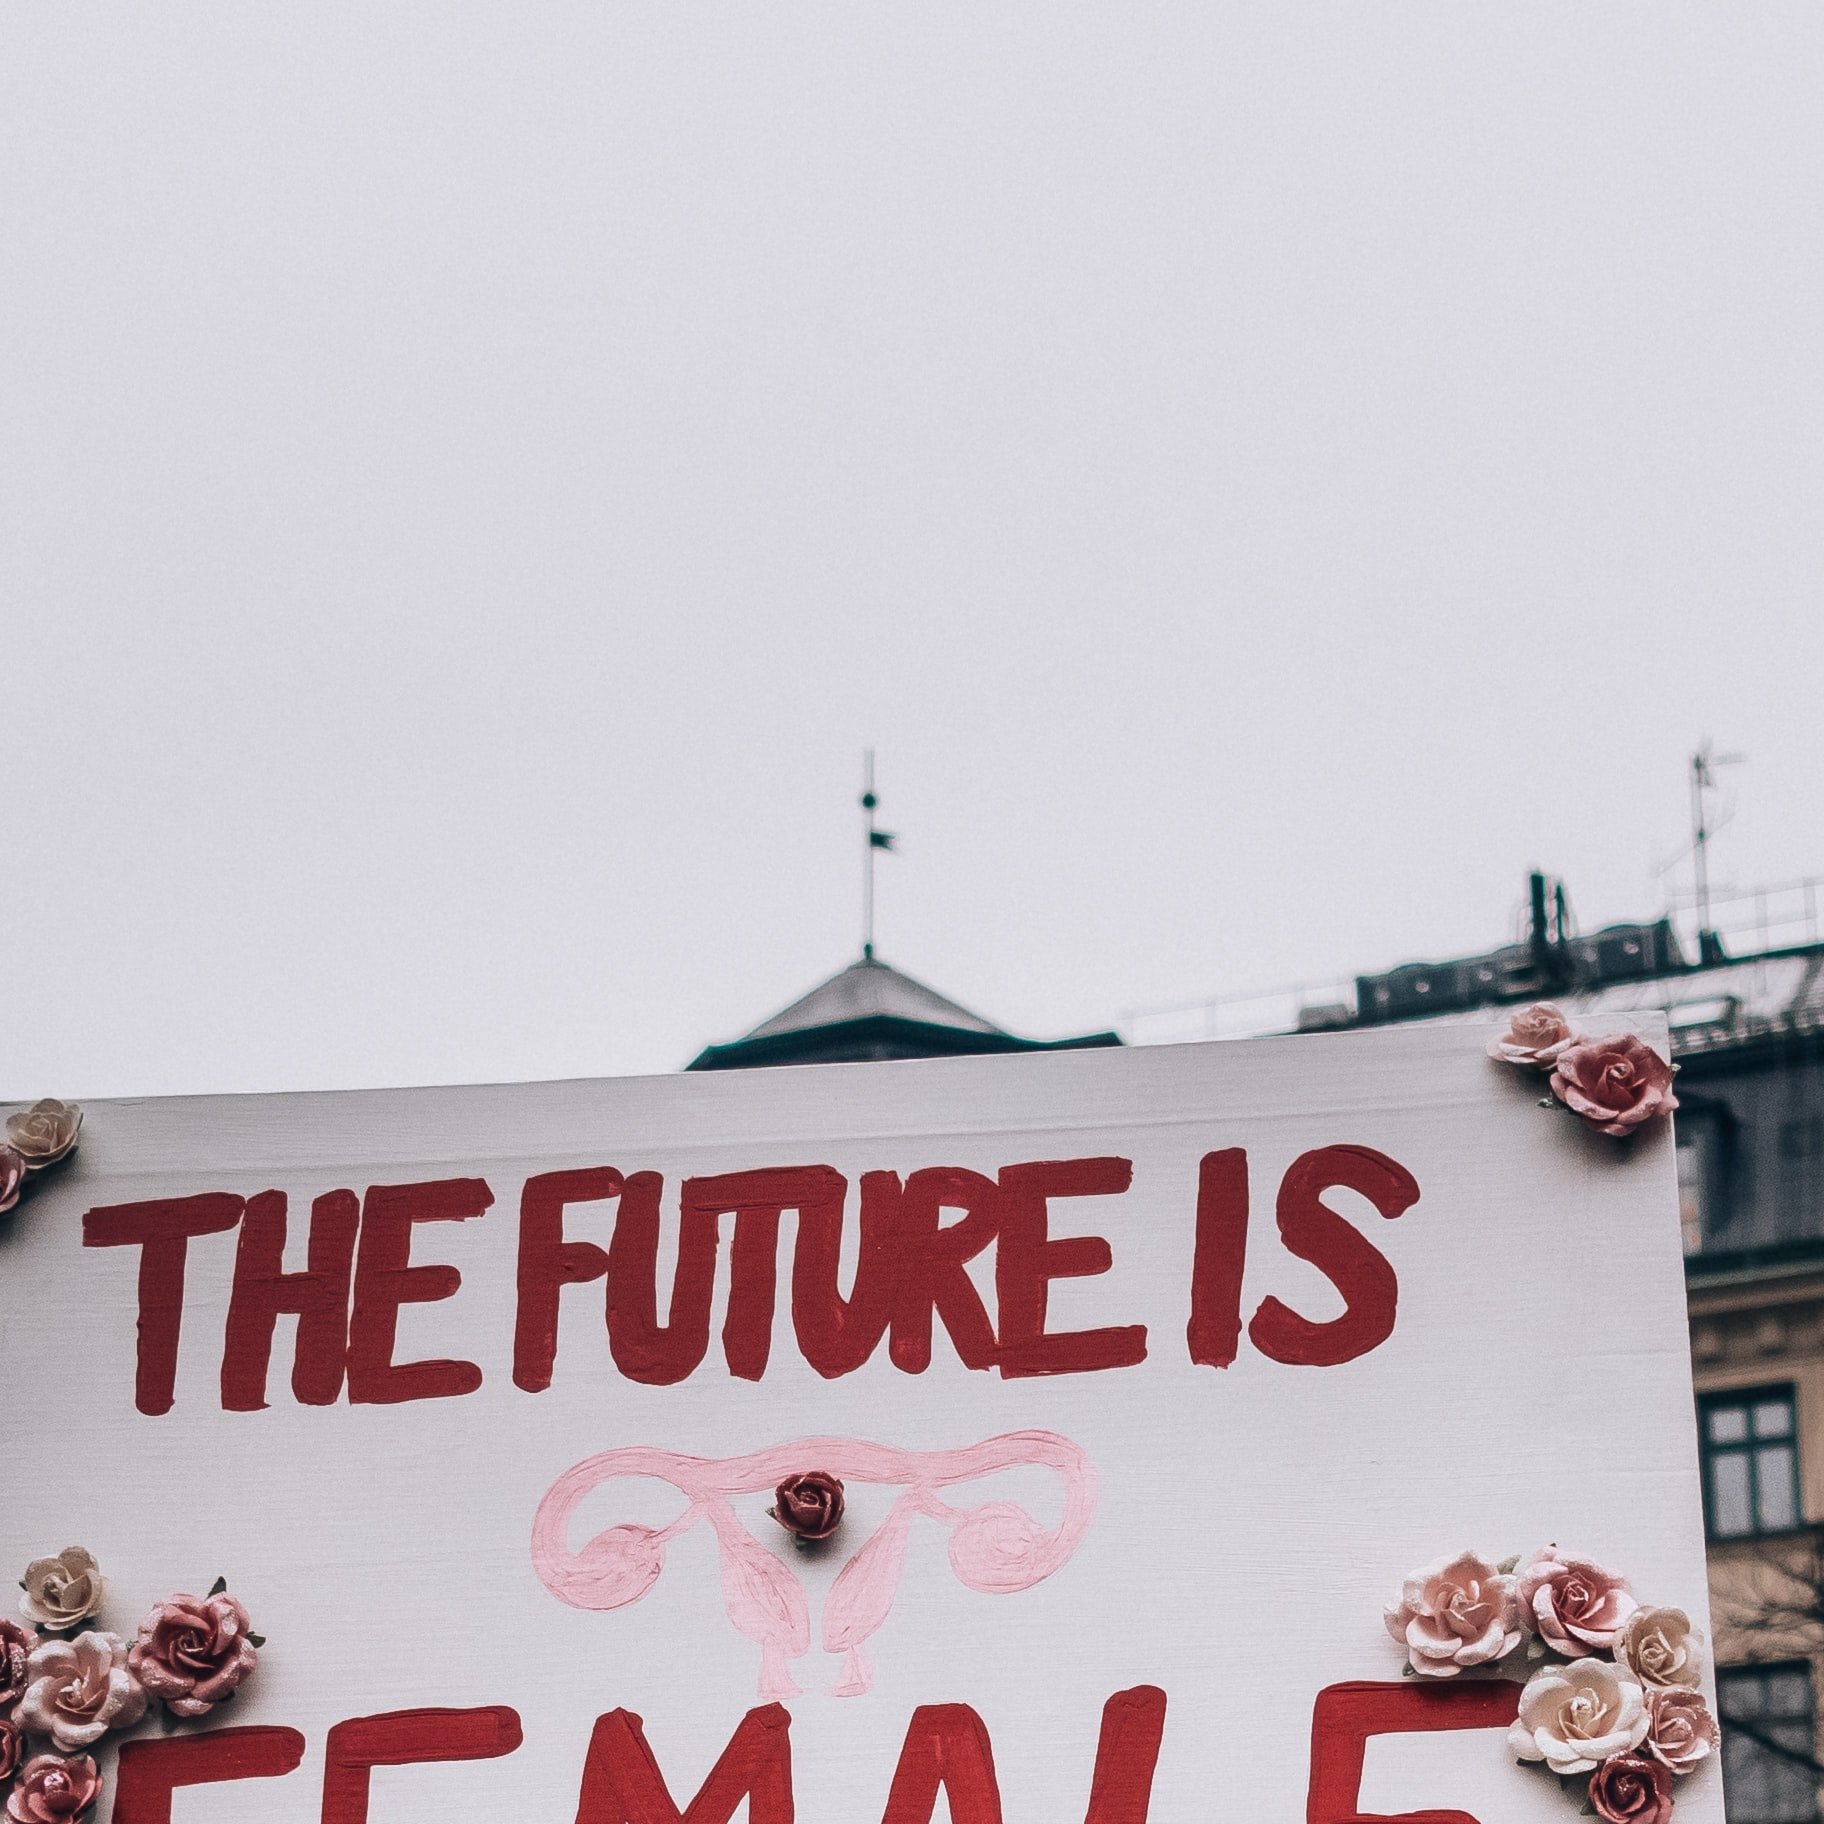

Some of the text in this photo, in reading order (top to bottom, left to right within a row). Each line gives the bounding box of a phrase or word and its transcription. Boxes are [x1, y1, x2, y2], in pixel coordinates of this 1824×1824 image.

[82, 1144, 1422, 1416] THE FUTURE IS
